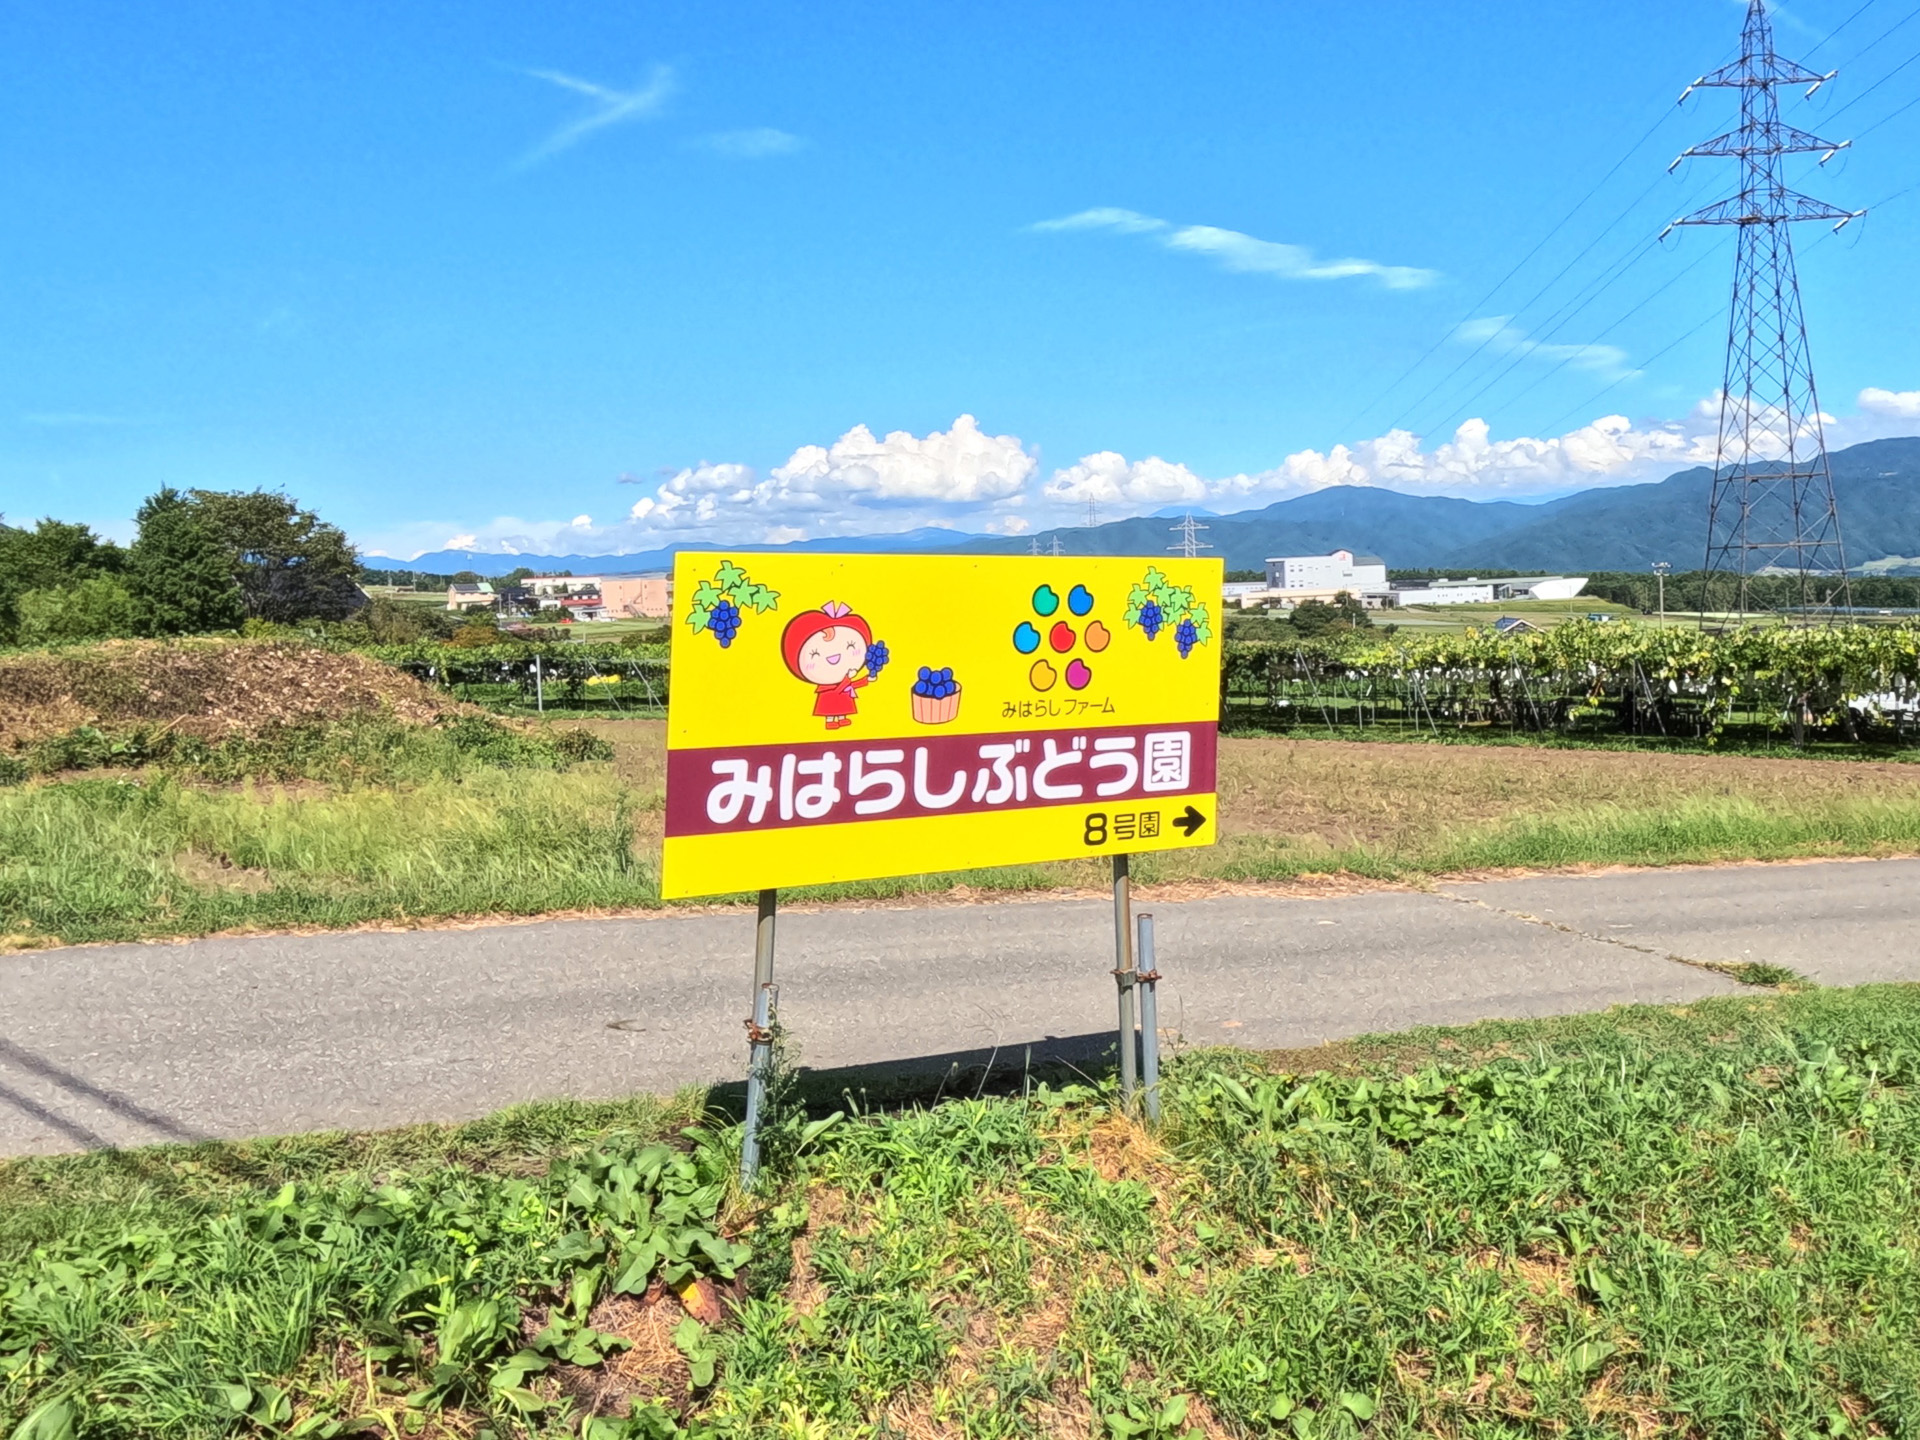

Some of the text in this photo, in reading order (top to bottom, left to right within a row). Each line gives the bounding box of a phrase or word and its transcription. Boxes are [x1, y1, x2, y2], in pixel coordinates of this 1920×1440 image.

[1001, 697, 1116, 719] みはらしファーム
[706, 731, 1191, 824] みはらしぶどう園
[1084, 811, 1160, 846] 8号園
